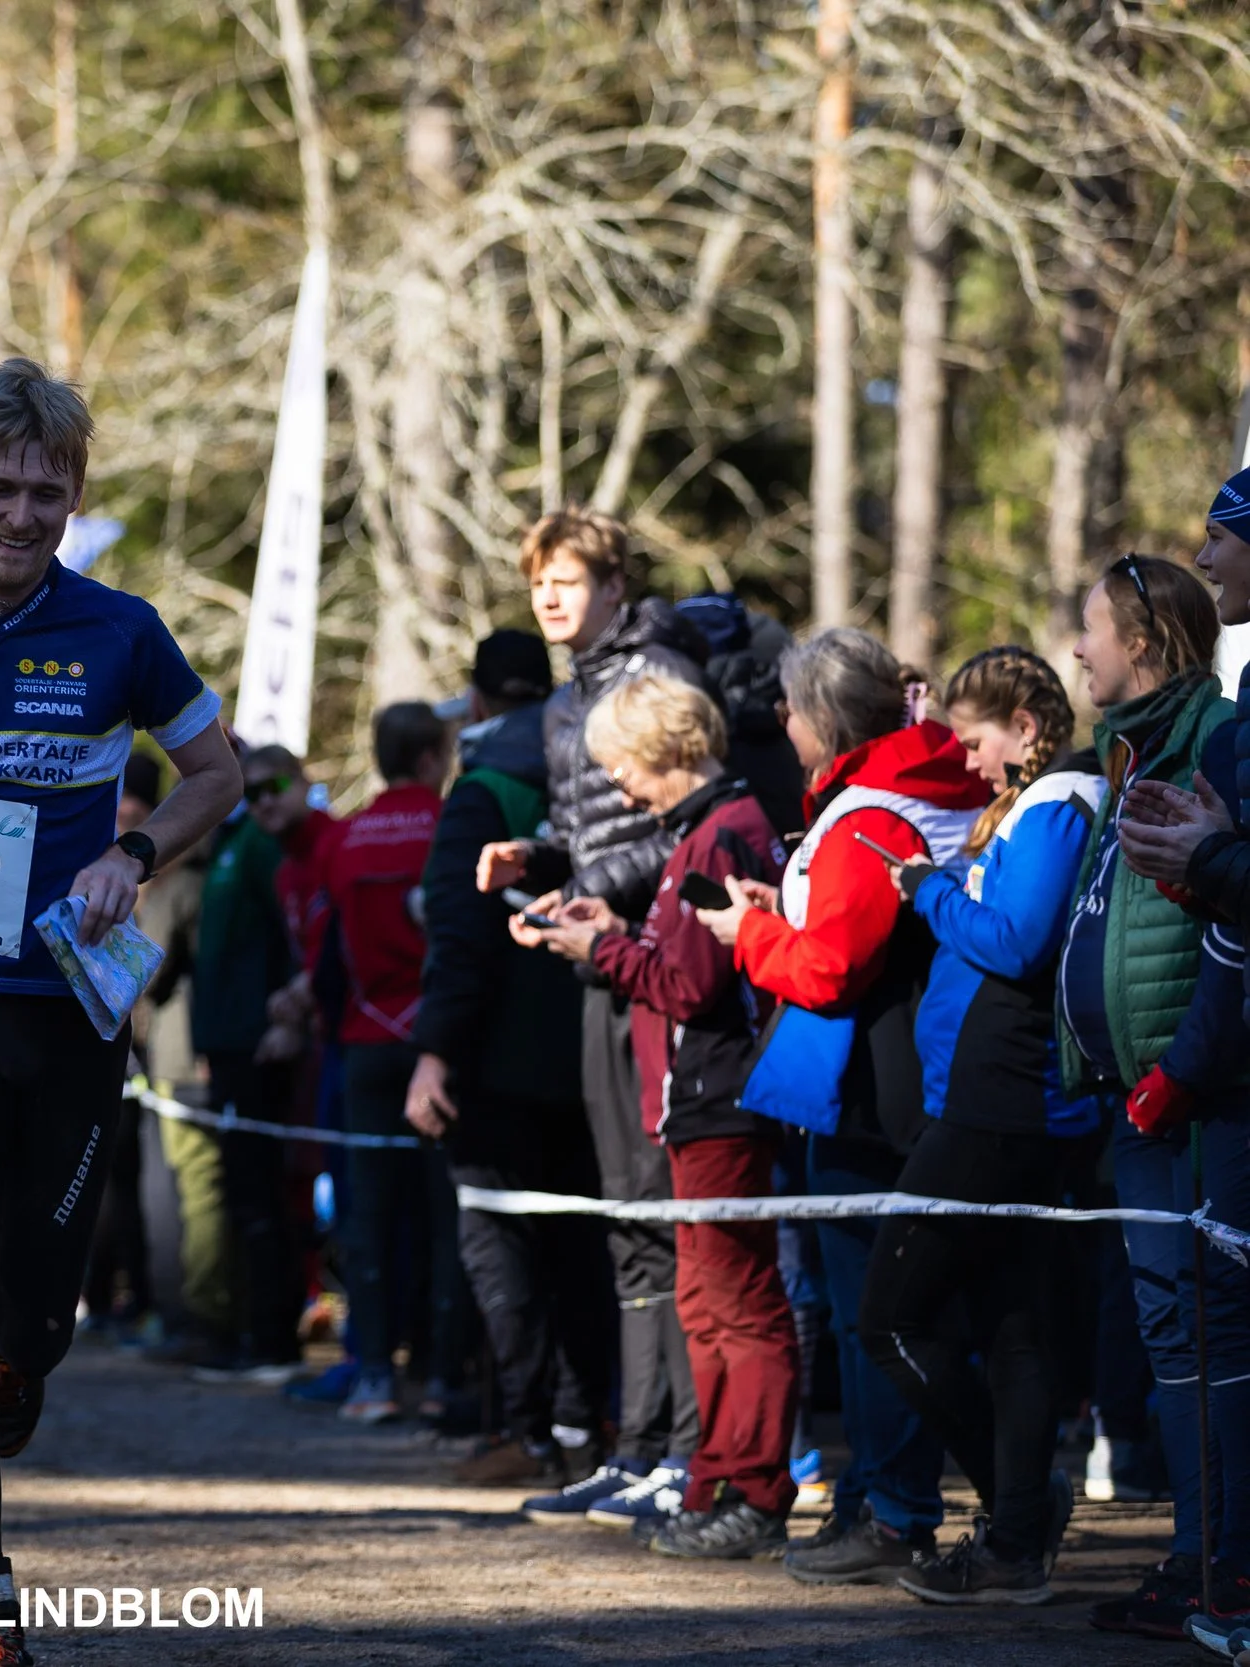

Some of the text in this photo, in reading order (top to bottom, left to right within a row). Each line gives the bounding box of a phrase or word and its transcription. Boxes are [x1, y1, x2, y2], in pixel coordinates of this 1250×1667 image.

[3, 584, 50, 630] noname
[14, 684, 87, 696] ORIENTERING
[14, 701, 84, 717] SCANIA
[53, 1124, 101, 1226] noname
